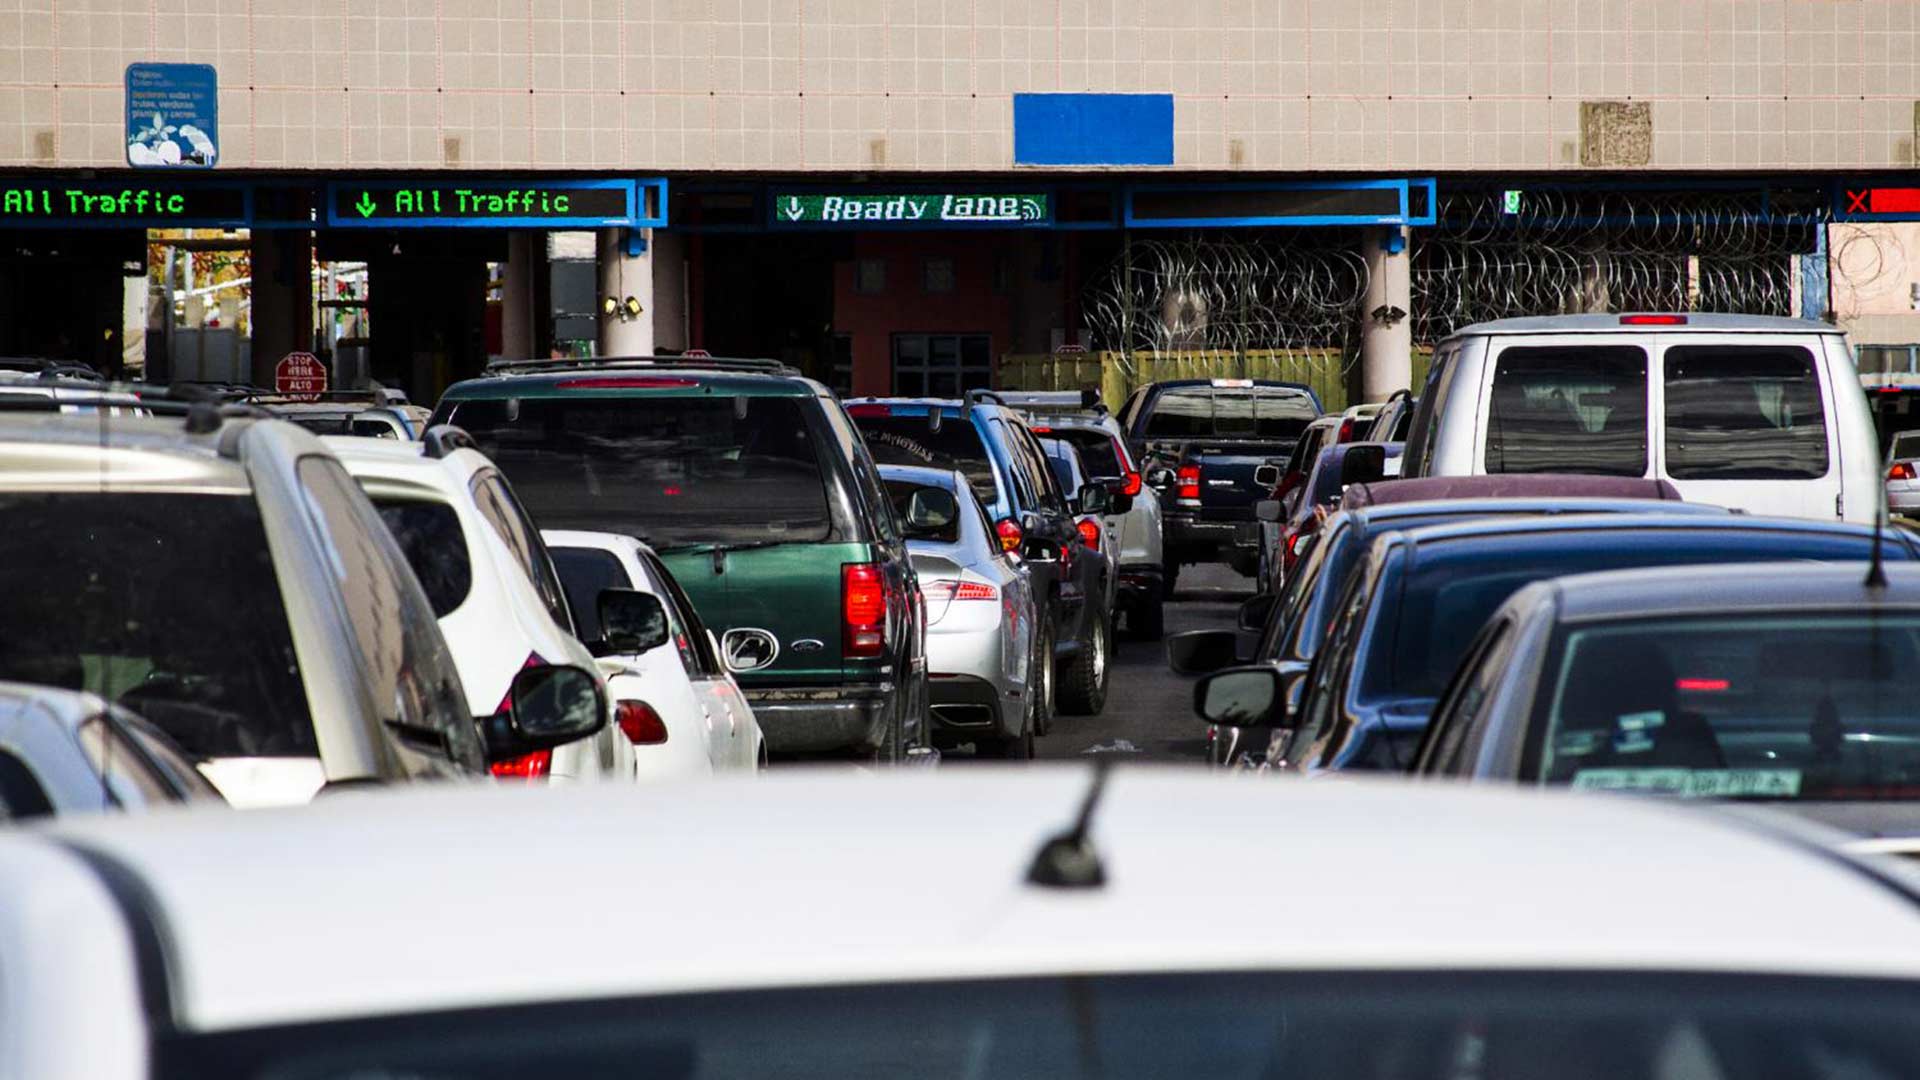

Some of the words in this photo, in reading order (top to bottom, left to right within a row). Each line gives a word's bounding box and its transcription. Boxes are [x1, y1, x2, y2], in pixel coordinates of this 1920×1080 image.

[4, 189, 52, 214] All
[65, 189, 184, 214] Traffic
[395, 189, 441, 213] All
[455, 189, 570, 213] Traffic
[822, 195, 928, 222] Ready
[939, 194, 1022, 222] Lane
[287, 356, 312, 366] STOP
[287, 366, 313, 376] HERE
[289, 381, 312, 391] ALTO
